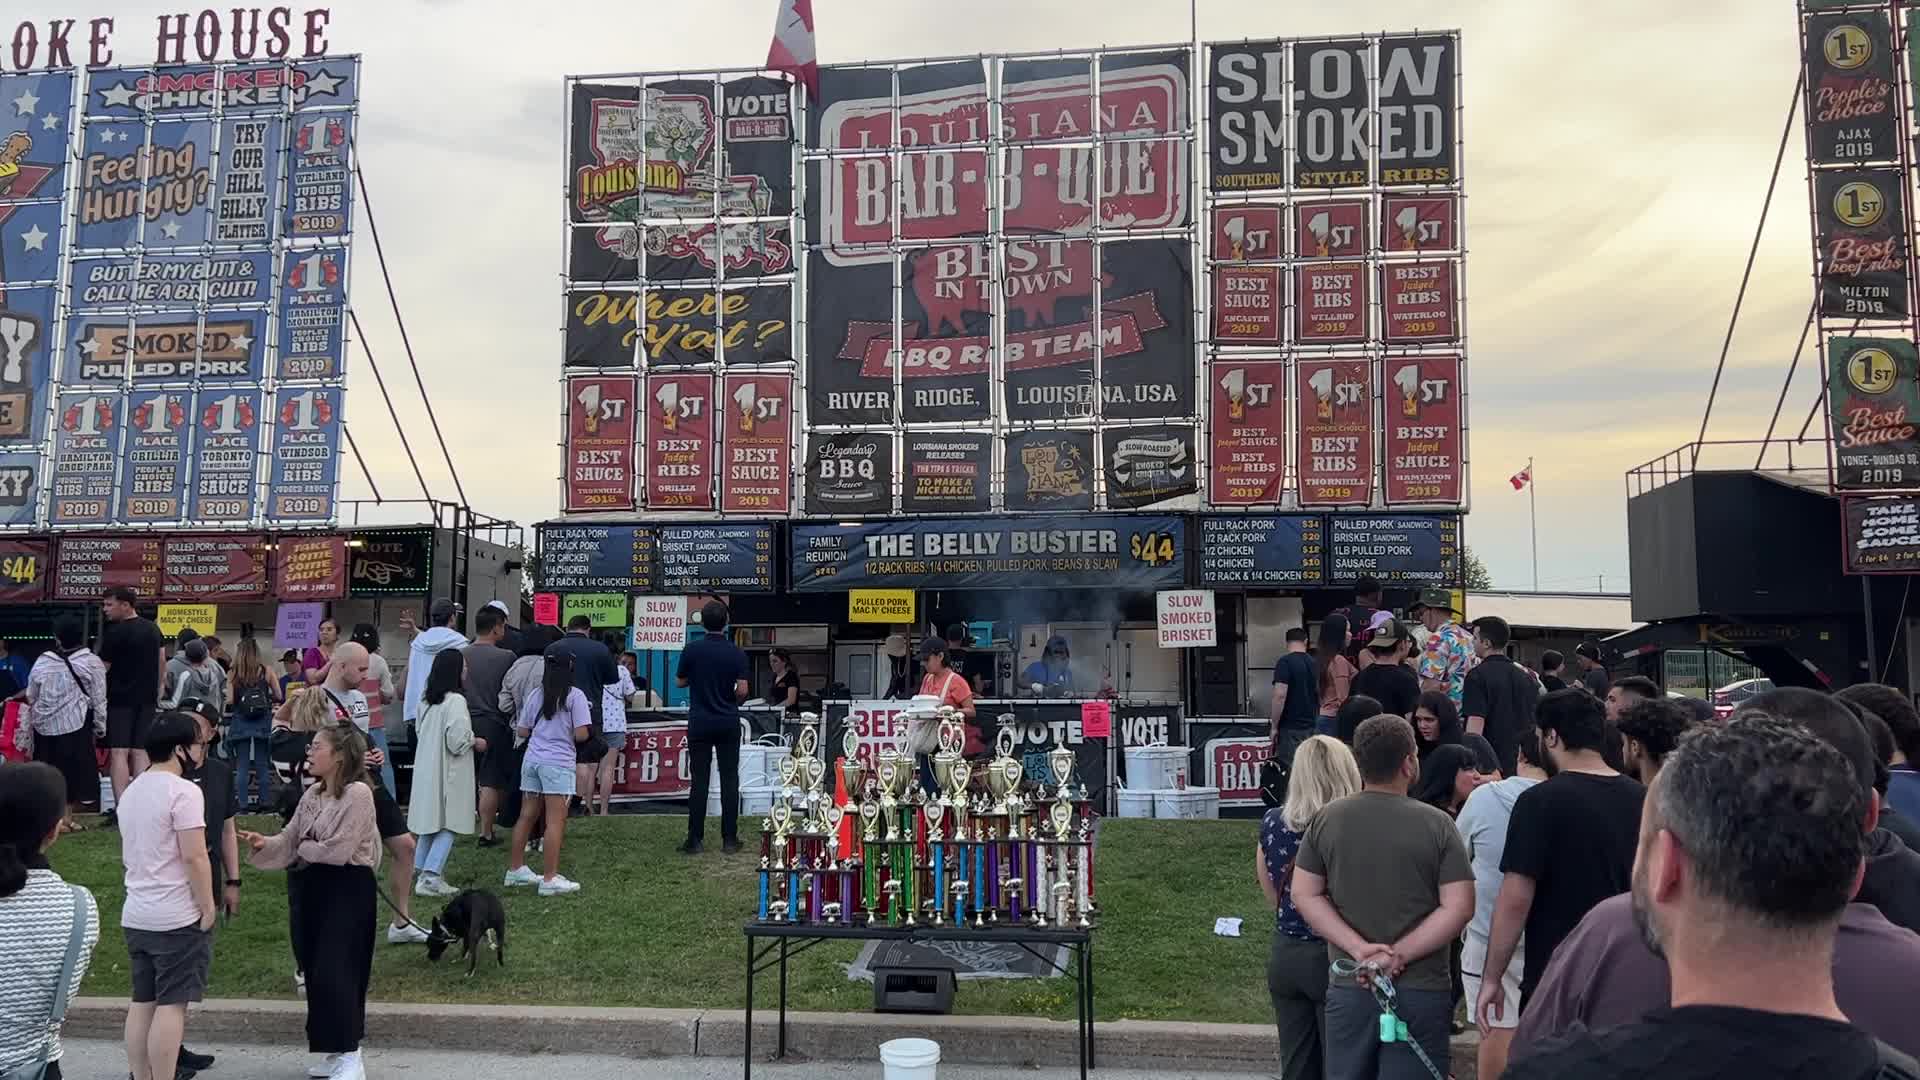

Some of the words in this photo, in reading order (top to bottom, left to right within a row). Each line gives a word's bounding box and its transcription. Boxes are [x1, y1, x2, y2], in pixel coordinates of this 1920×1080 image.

[156, 6, 331, 64] HOUSE
[1833, 32, 1865, 60] 1ST
[1216, 46, 1445, 104] SLOW
[1816, 78, 1889, 107] People's
[727, 94, 788, 116] VOTE
[857, 101, 1159, 150] LOUISIANA
[235, 122, 266, 146] TRY
[1219, 104, 1444, 165] SMOKED
[1837, 128, 1872, 140] AJAX
[1835, 142, 1873, 157] 2019
[85, 143, 193, 187] Feeling
[232, 147, 264, 169] OUR
[297, 156, 340, 168] PLACE
[226, 173, 264, 194] HILL
[1215, 172, 1281, 188] SOUTHERN
[1300, 170, 1365, 185] STYLE
[1383, 167, 1450, 183] RIBS
[81, 170, 209, 225] Hungry?
[295, 196, 342, 212] RIBS
[1845, 188, 1879, 217] 1ST
[219, 198, 266, 219] BILLY
[217, 223, 266, 241] PLATTER
[1827, 235, 1897, 261] Best
[935, 241, 1073, 280] BEST
[1395, 266, 1441, 280] BEST
[1225, 277, 1269, 291] BEST
[1311, 275, 1353, 290] BEST
[935, 281, 963, 299] IN
[1839, 286, 1889, 298] MILTON
[289, 293, 333, 305] PLACE
[1224, 294, 1270, 309] SAUCE
[1314, 292, 1352, 308] RIBS
[1396, 291, 1441, 305] RIBS
[575, 291, 749, 326] Where
[1392, 311, 1446, 321] WATERLOO
[1230, 324, 1261, 333] 2019
[1404, 322, 1435, 332] 2019
[112, 332, 233, 357] SMOKED
[291, 341, 328, 353] RIBS
[84, 361, 177, 378] PULLED
[1858, 355, 1892, 386] 1ST
[828, 391, 890, 410] RIVER
[914, 387, 981, 408] RIDGE,
[1135, 383, 1177, 403] USA
[577, 384, 625, 432] 1ST
[656, 383, 704, 432] 1ST
[733, 383, 782, 432] 1ST
[1848, 405, 1905, 429] Best
[281, 433, 326, 444] PLACE
[1232, 427, 1267, 437] BEST
[1396, 426, 1448, 439] BEST
[1840, 424, 1916, 449] Sauce
[64, 438, 108, 449] PLACE
[135, 437, 178, 447] PLACE
[204, 437, 248, 447] PLACE
[656, 439, 701, 451] BEST
[1142, 444, 1172, 452] ROASTED
[1310, 436, 1359, 453] BEST
[201, 451, 251, 462] TORONTO
[279, 448, 329, 458] WINDSOR
[577, 450, 622, 465] BEST
[732, 448, 778, 463] BEST
[818, 443, 877, 459] Legendary
[1232, 453, 1265, 463] BEST
[1312, 456, 1357, 472] RIBS
[1395, 455, 1450, 468] SAUCE
[1841, 455, 1906, 467] YONGE-DUNDAS
[283, 470, 323, 482] RIBS
[575, 467, 624, 481] SAUCE
[657, 464, 701, 477] RIBS
[731, 465, 780, 481] SAUCE
[1861, 469, 1903, 484] 2019
[132, 480, 174, 494] RIBS
[200, 480, 248, 495] SAUCE
[730, 487, 781, 495] ANCASTER
[133, 502, 169, 514] 2019
[738, 496, 769, 506] 2019
[64, 503, 100, 516] 2019
[205, 503, 241, 515] 2019
[1867, 503, 1916, 516] TAKE
[1203, 520, 1225, 531] FULL
[1225, 520, 1250, 530] RACK
[1250, 520, 1276, 530] PORK
[1862, 514, 1920, 527] HOME
[545, 529, 565, 539] FULL
[565, 529, 588, 538] RACK
[587, 529, 609, 538] PORK
[1216, 533, 1241, 543] RACK
[1241, 533, 1267, 543] PORK
[1302, 533, 1320, 541] $20
[1861, 525, 1918, 538] SOME
[557, 541, 579, 550] RACK
[579, 541, 600, 550] PORK
[632, 542, 650, 550] $20
[809, 536, 842, 548] FAMILY
[864, 535, 914, 557] THE
[923, 532, 1001, 556] BELLY
[1010, 530, 1118, 554] BUSTER
[805, 550, 848, 563] REUNION
[1131, 533, 1175, 567] $44
[1204, 546, 1216, 556] 1/2
[1216, 546, 1255, 556] CHICKEN
[676, 554, 707, 563] PULLED
[707, 554, 731, 563] PORK
[1204, 558, 1216, 568] 1/4
[1216, 558, 1254, 568] CHICKEN
[1302, 558, 1321, 567] $10
[1335, 558, 1377, 569] SAUSAGE
[2, 557, 36, 585] $44
[864, 563, 878, 575] 1/2
[878, 562, 903, 574] RACK
[929, 561, 942, 572] 1/4
[986, 560, 1021, 572] PULLED
[1052, 559, 1082, 571] BEANS
[1084, 559, 1091, 570] &
[1092, 558, 1120, 570] SLAW
[566, 600, 594, 609] CASH
[595, 599, 625, 609] ONLY
[646, 601, 677, 613] SLOW
[1167, 594, 1204, 608] SLOW
[638, 617, 683, 629] SMOKED
[1160, 611, 1213, 625] SMOKED
[635, 631, 684, 644] SAUSAGE
[1162, 628, 1215, 642] BRISKET
[1011, 720, 1084, 745] VOTE
[1121, 716, 1169, 747] VOTE
